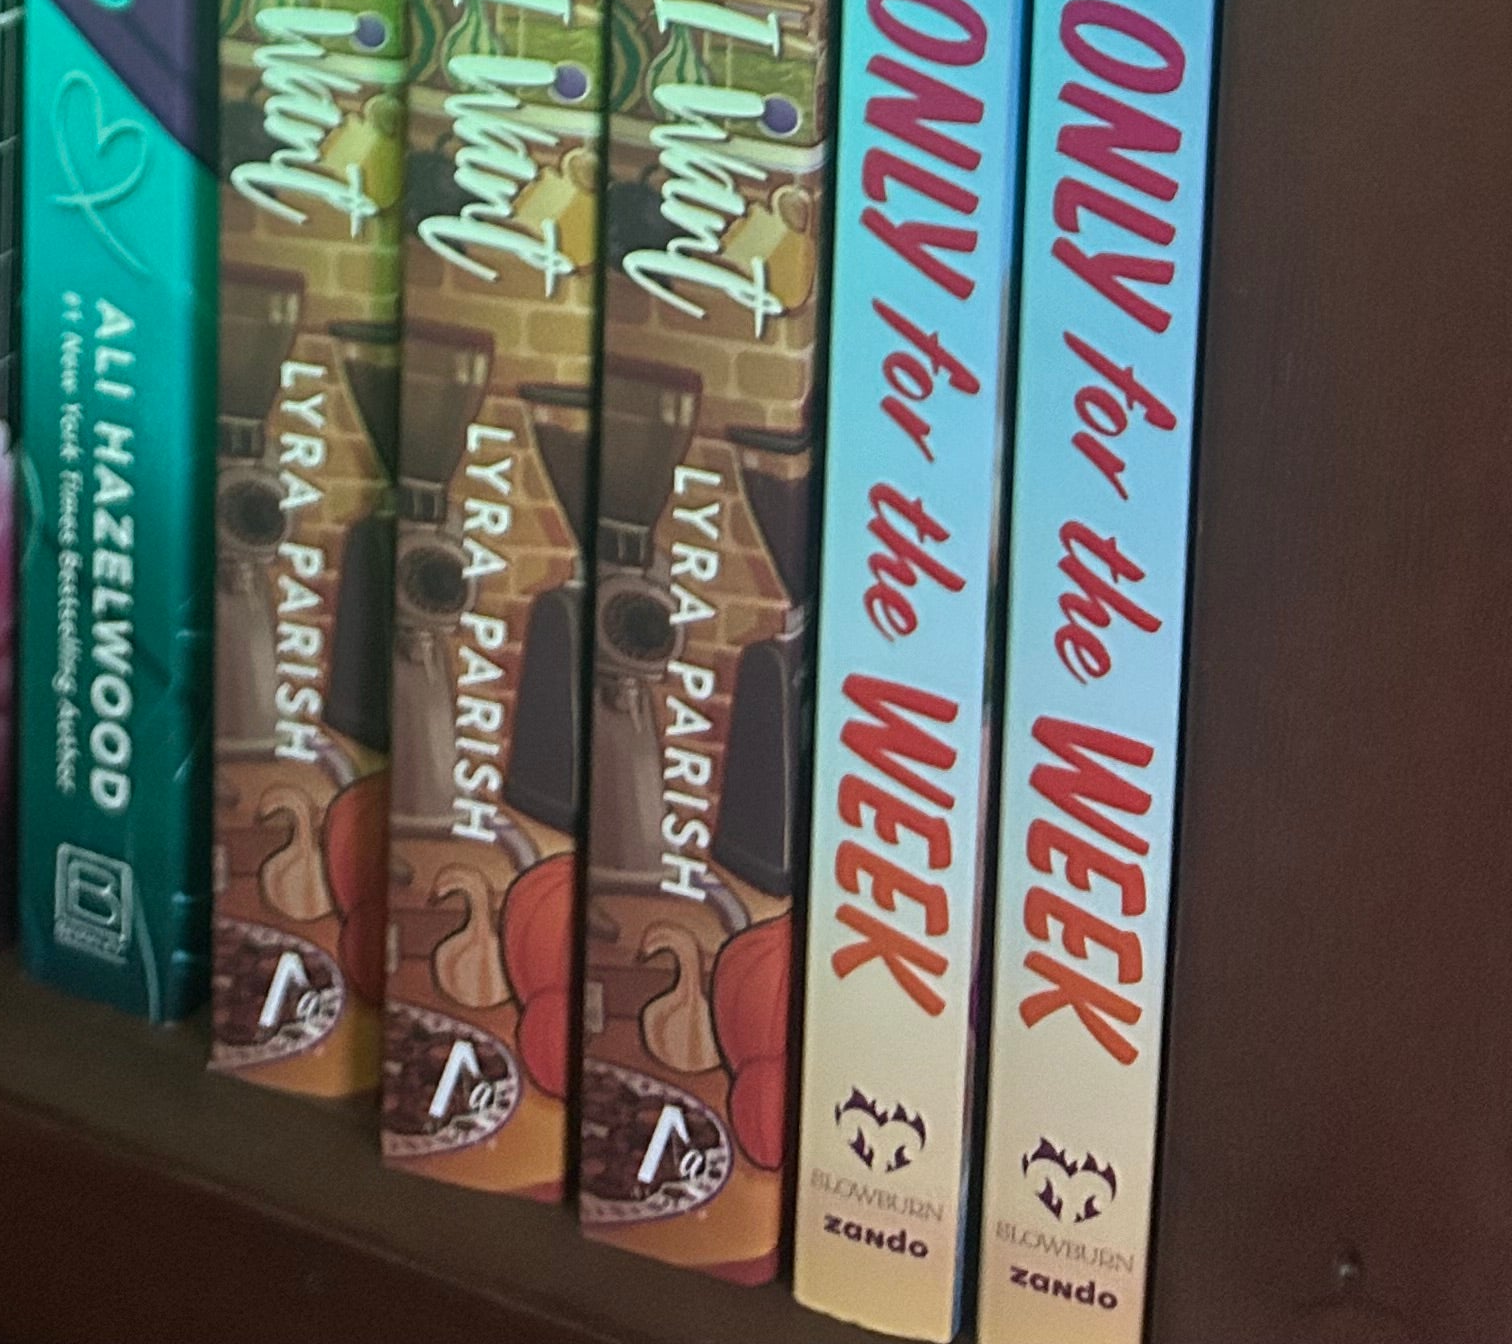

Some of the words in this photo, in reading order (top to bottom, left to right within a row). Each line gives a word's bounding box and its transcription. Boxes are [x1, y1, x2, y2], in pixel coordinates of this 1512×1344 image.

[230, 6, 378, 238] Want
[418, 55, 576, 296] Want
[623, 84, 783, 338] Want
[59, 402, 85, 460] York
[60, 331, 85, 393] New
[94, 299, 137, 400] ALI
[872, 298, 980, 463] for
[1064, 330, 1177, 500] for
[58, 469, 85, 546] Times
[278, 360, 326, 511] LYRA
[462, 423, 515, 579] LYRA
[51, 551, 84, 693] Bestselling
[91, 422, 136, 812] HAZELWOOD
[670, 465, 721, 626] LYRA
[864, 482, 966, 642] the
[1055, 521, 1163, 685] the
[275, 542, 324, 762] PARISH
[452, 612, 507, 843] PARISH
[54, 699, 83, 795] Author
[660, 659, 716, 902] PARISH
[831, 673, 959, 1017] WEEK
[1019, 716, 1155, 1066] WEEK
